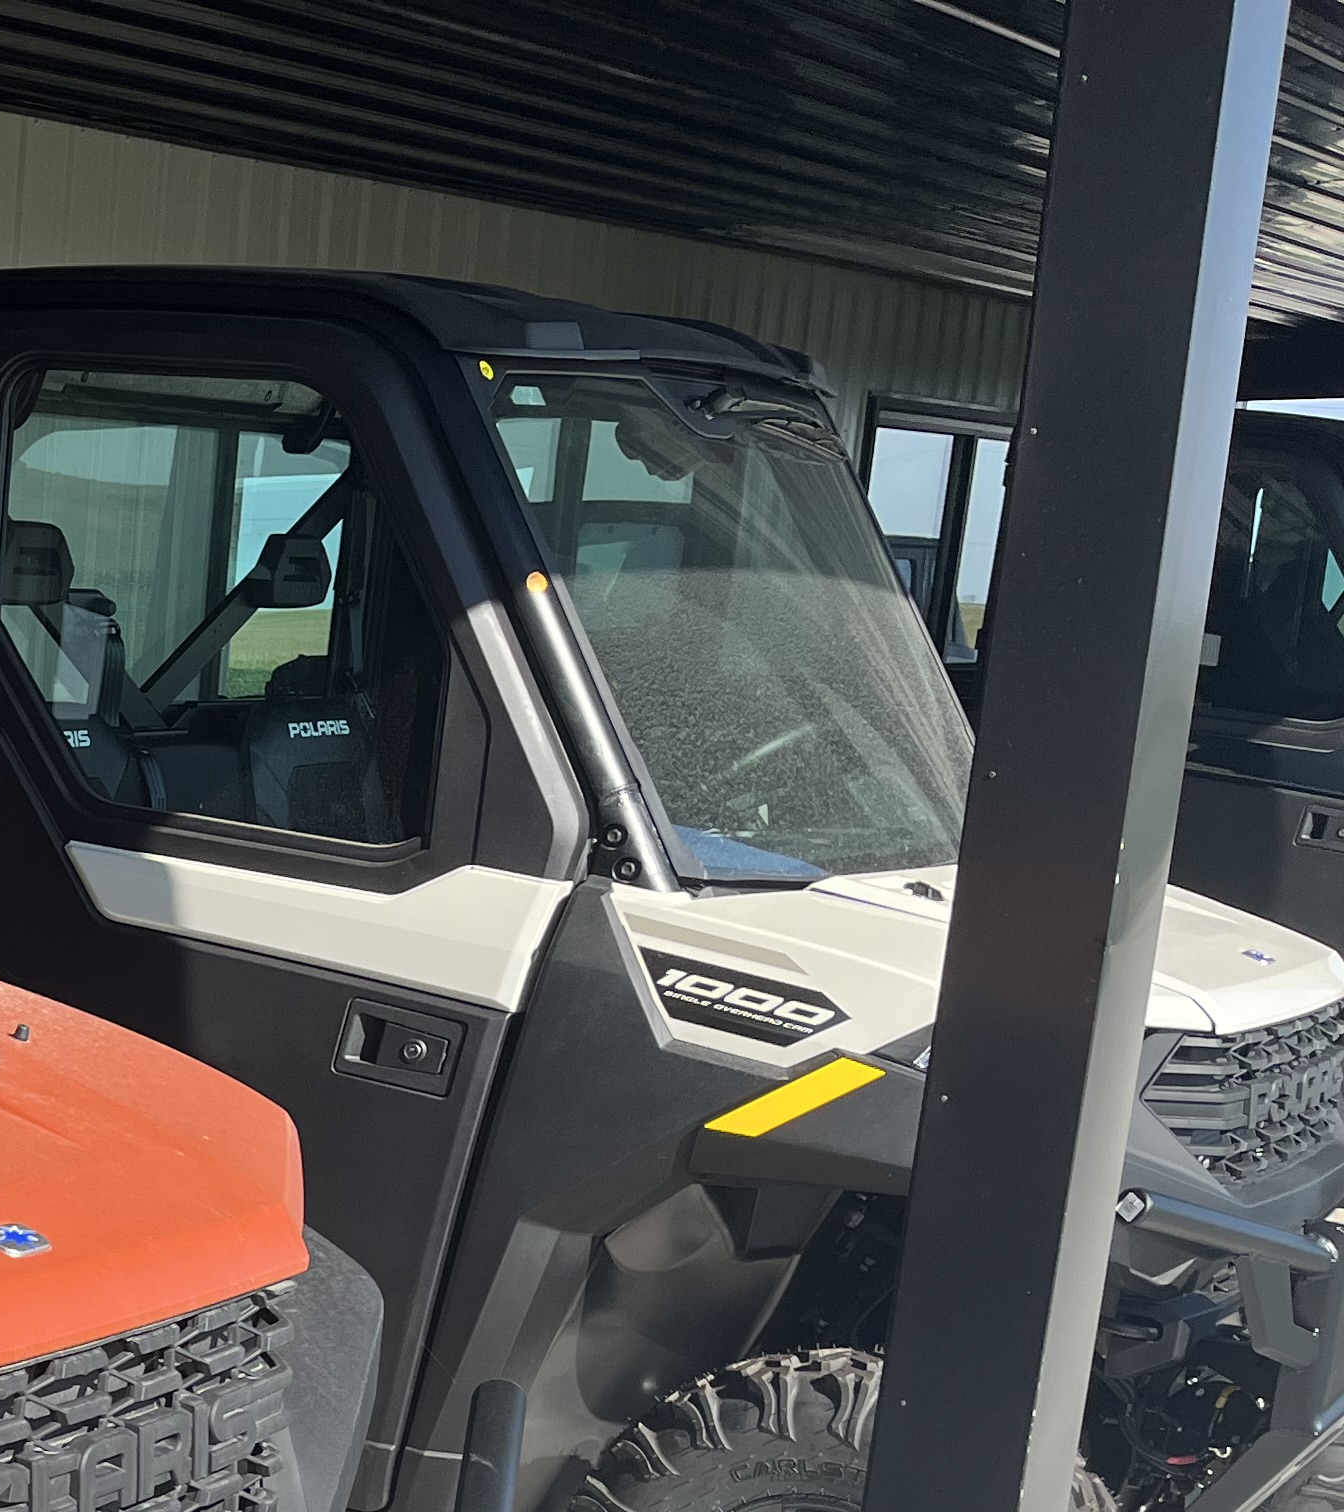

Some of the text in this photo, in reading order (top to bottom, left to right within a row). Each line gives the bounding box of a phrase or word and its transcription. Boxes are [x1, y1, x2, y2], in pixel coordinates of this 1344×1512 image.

[288, 720, 350, 739] POLARIS
[657, 968, 835, 1026] 1000
[663, 990, 814, 1035] SINGLE OVERHEAD CAM
